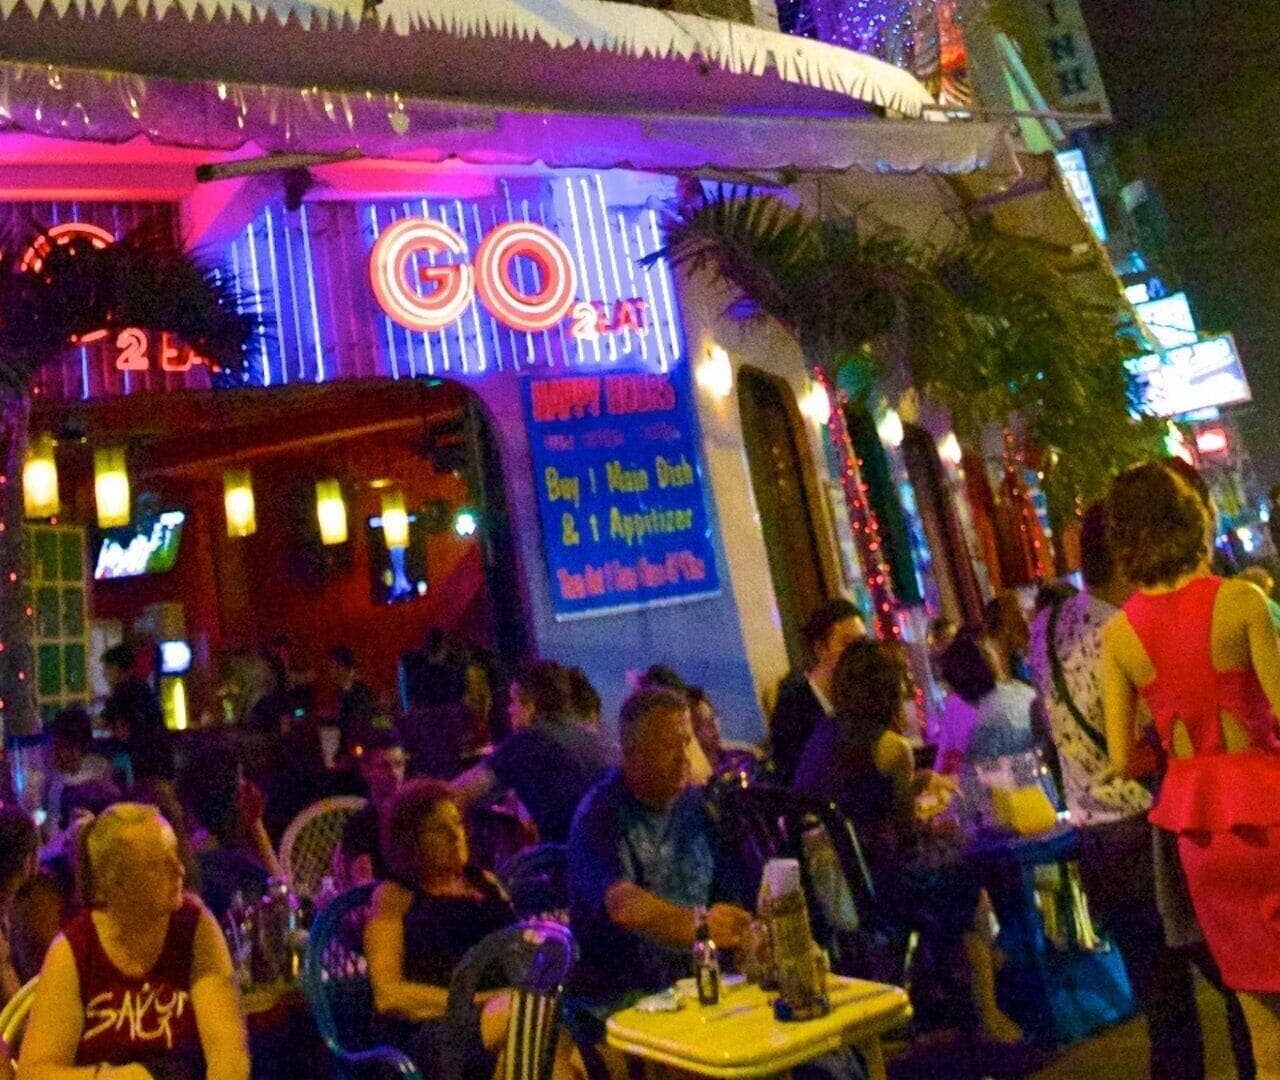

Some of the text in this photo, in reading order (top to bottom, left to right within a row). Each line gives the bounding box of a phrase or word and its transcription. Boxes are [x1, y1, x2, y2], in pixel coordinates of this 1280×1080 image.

[369, 217, 578, 332] GO
[116, 327, 150, 371] 2
[531, 378, 601, 422] HAPPY
[544, 465, 580, 509] Buy
